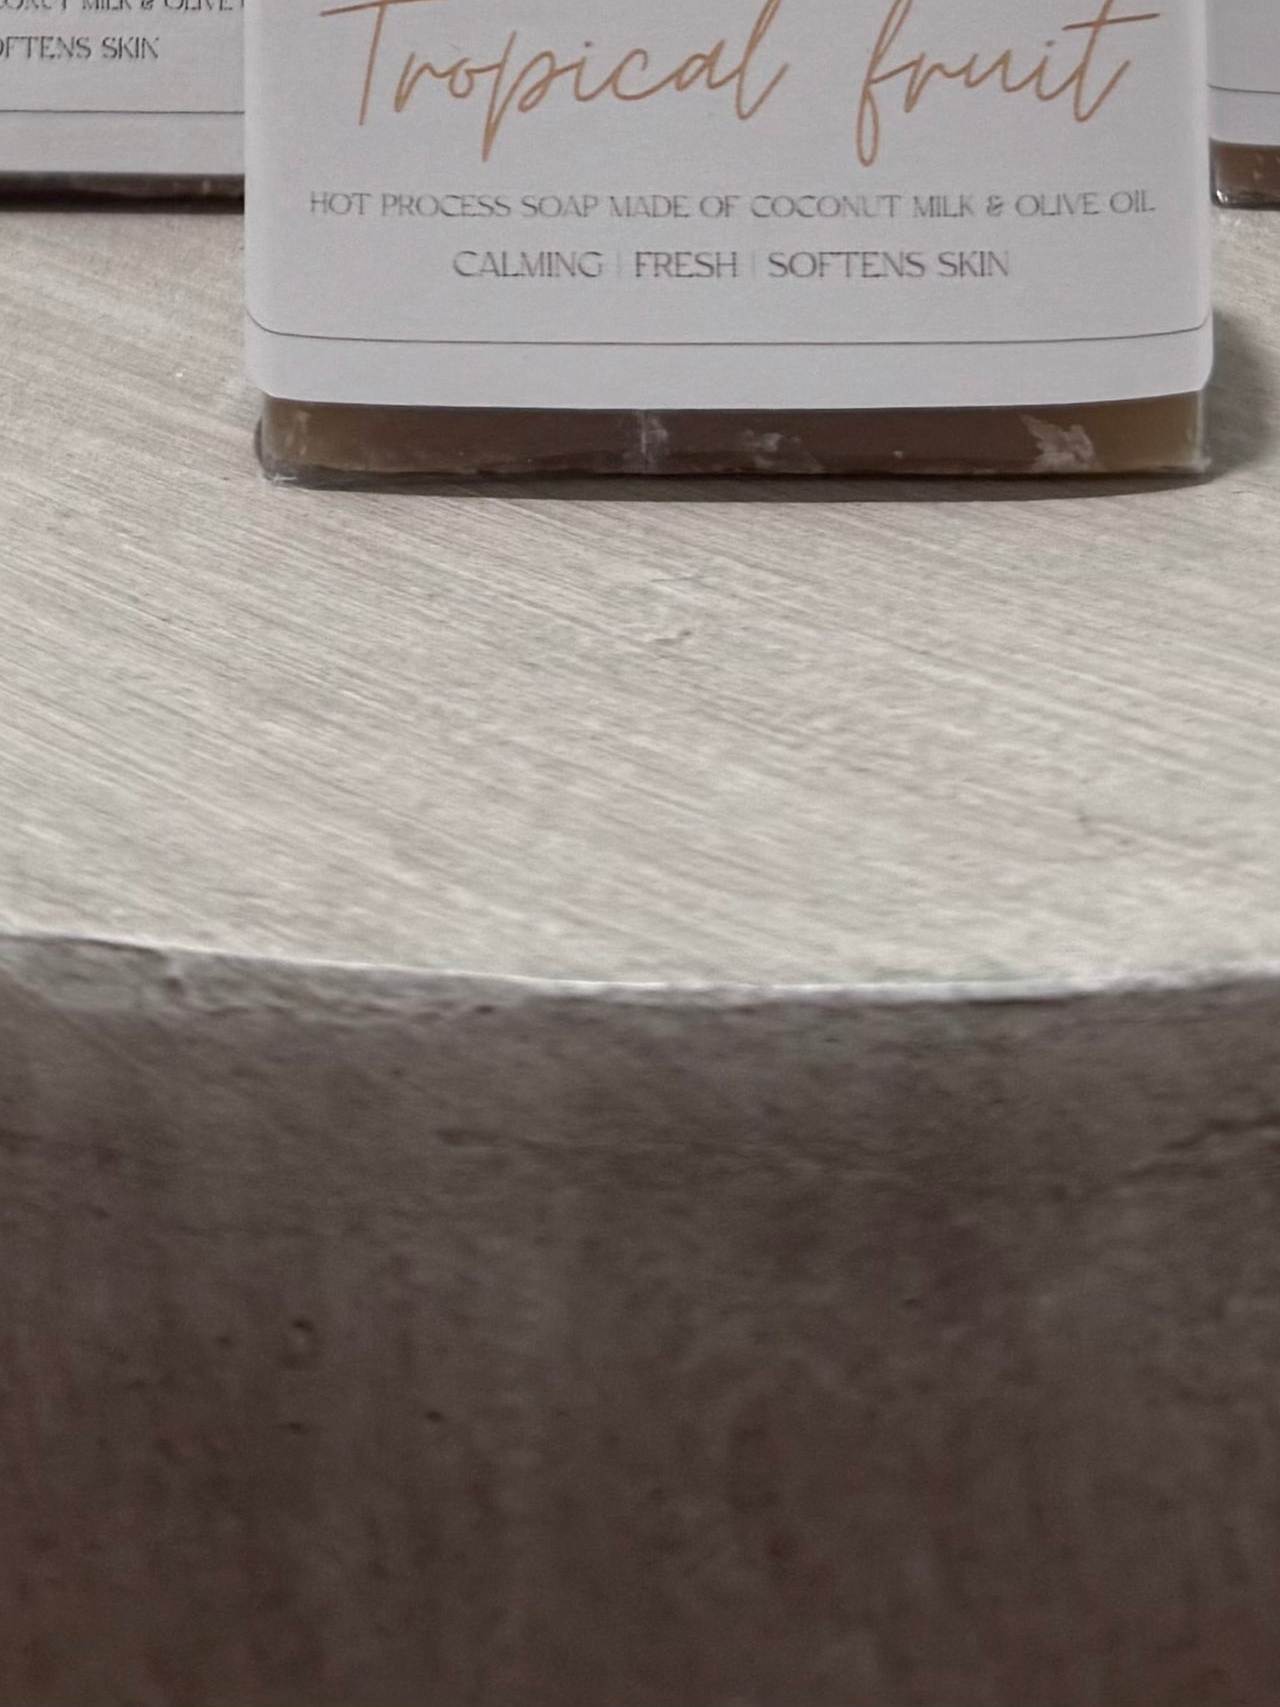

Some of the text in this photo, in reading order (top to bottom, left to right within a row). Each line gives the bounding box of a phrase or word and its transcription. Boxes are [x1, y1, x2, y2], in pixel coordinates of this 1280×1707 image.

[100, 36, 160, 61] SKIN
[309, 189, 1157, 219] HOT PROCESS SOAP MADE OF COCONUT MILK & OLIVE OIL
[452, 250, 1009, 279] CALMING FRESH SOFTENS SKIN
